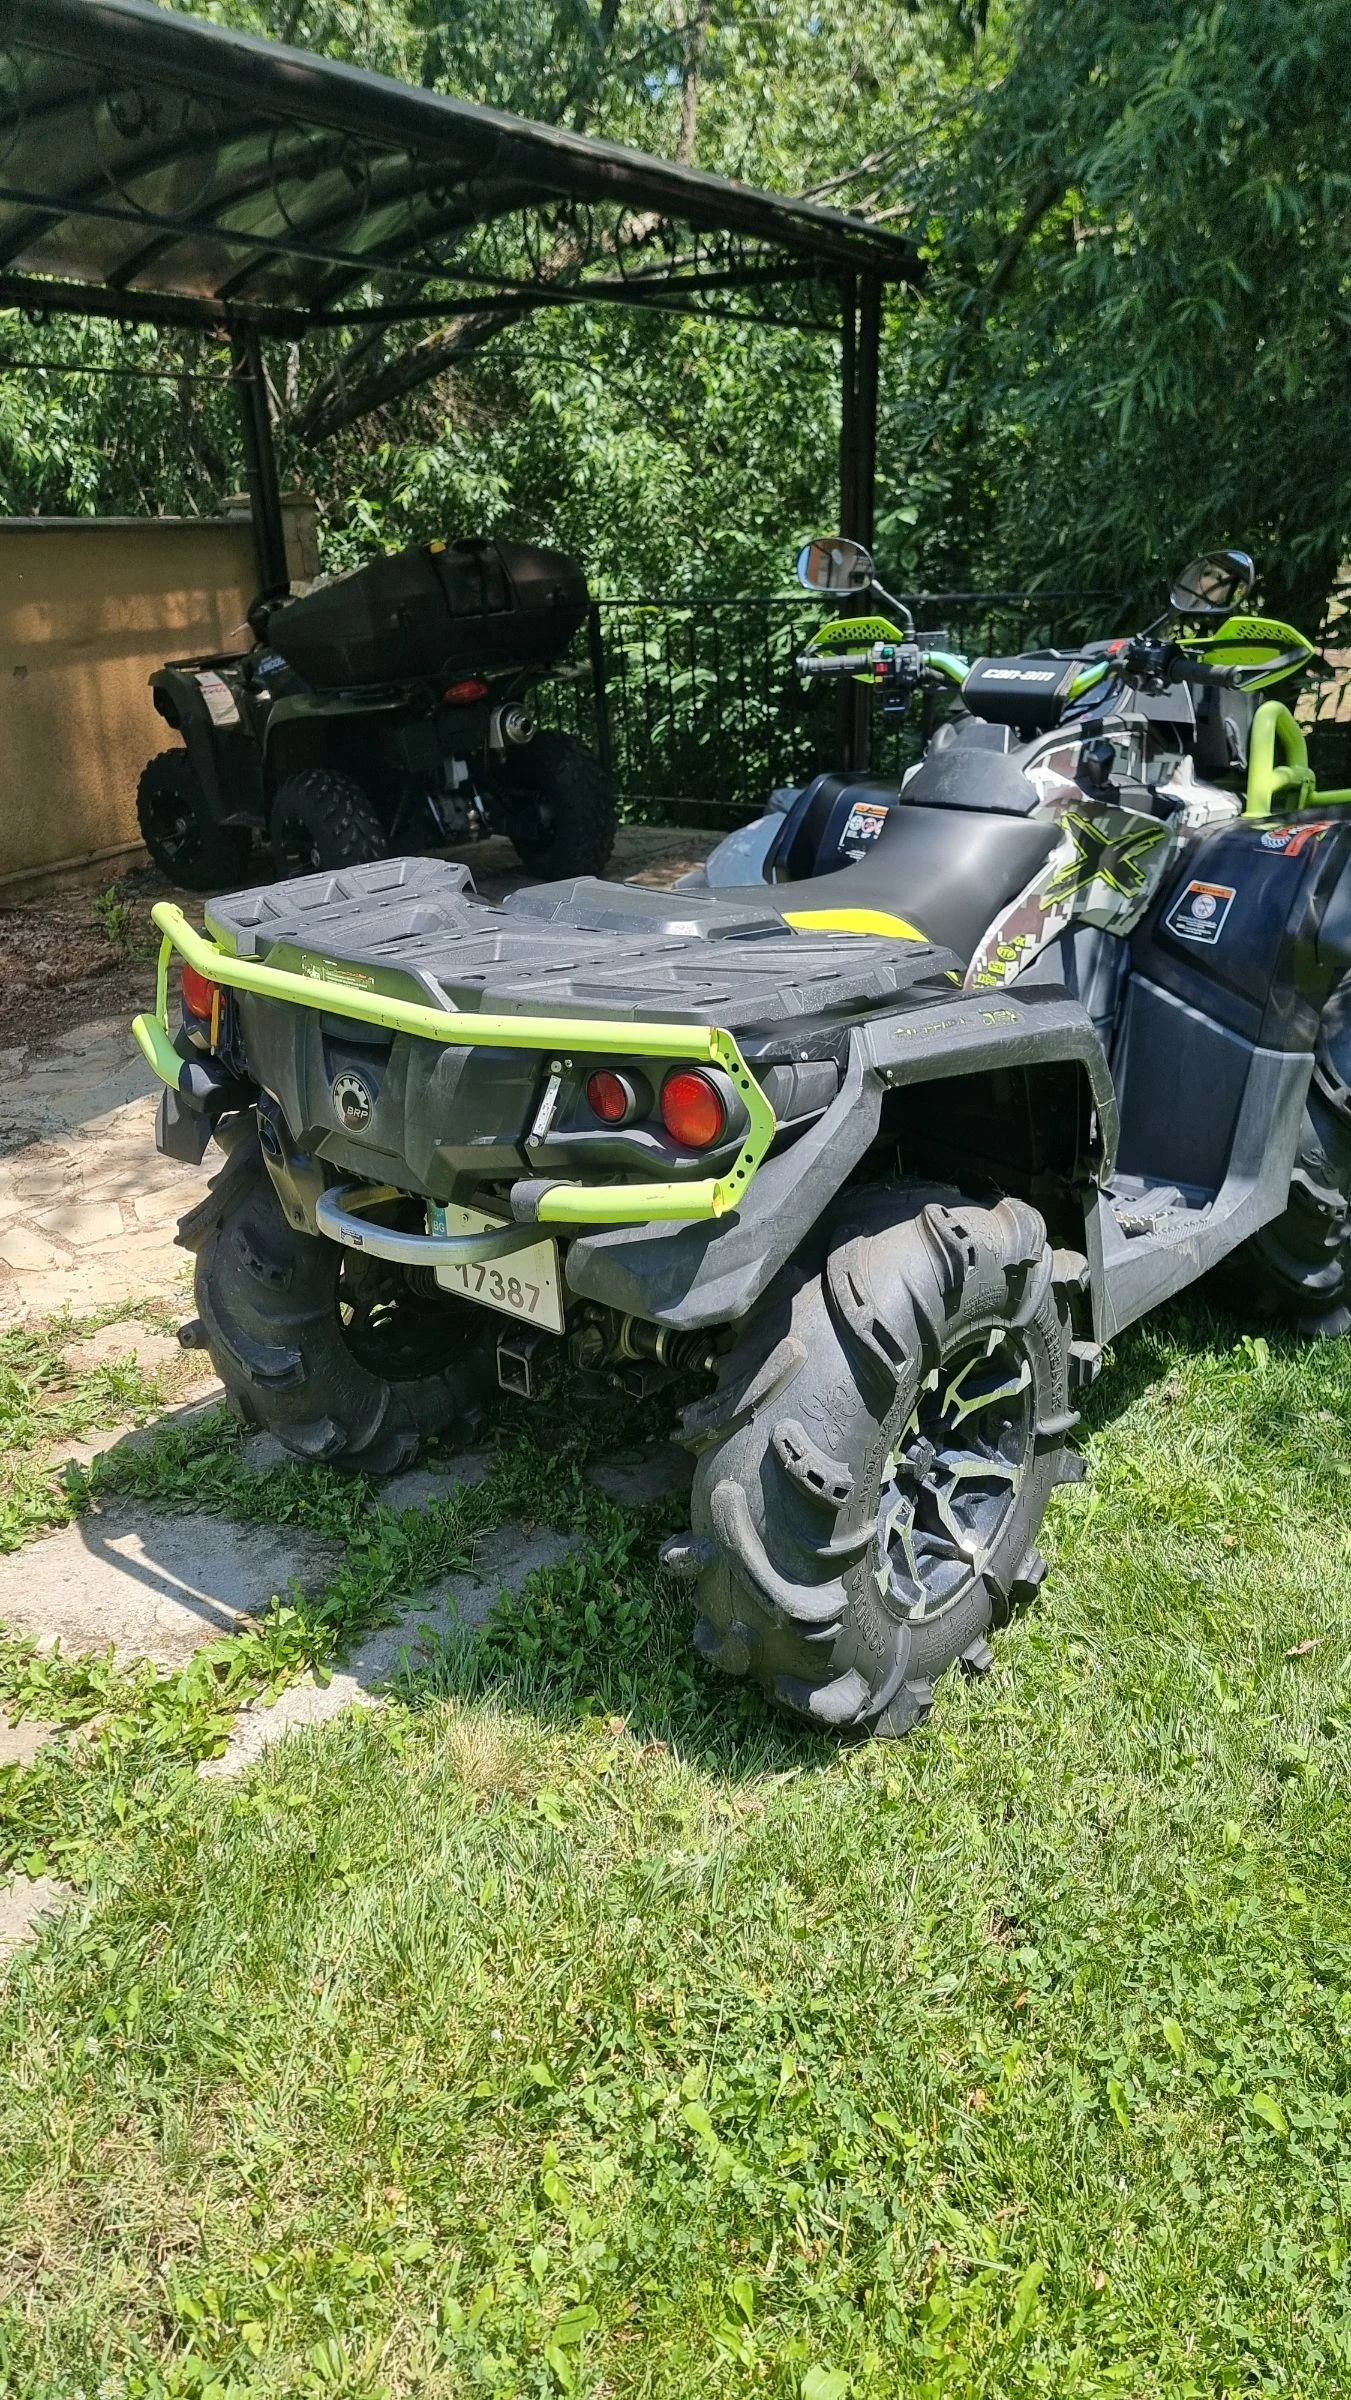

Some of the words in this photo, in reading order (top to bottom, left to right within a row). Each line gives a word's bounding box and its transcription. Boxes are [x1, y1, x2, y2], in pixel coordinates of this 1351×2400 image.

[347, 1106, 369, 1119] BRP
[433, 1221, 445, 1233] BG
[455, 1264, 541, 1314] 17387
[1035, 1302, 1063, 1413] ILVERBACK
